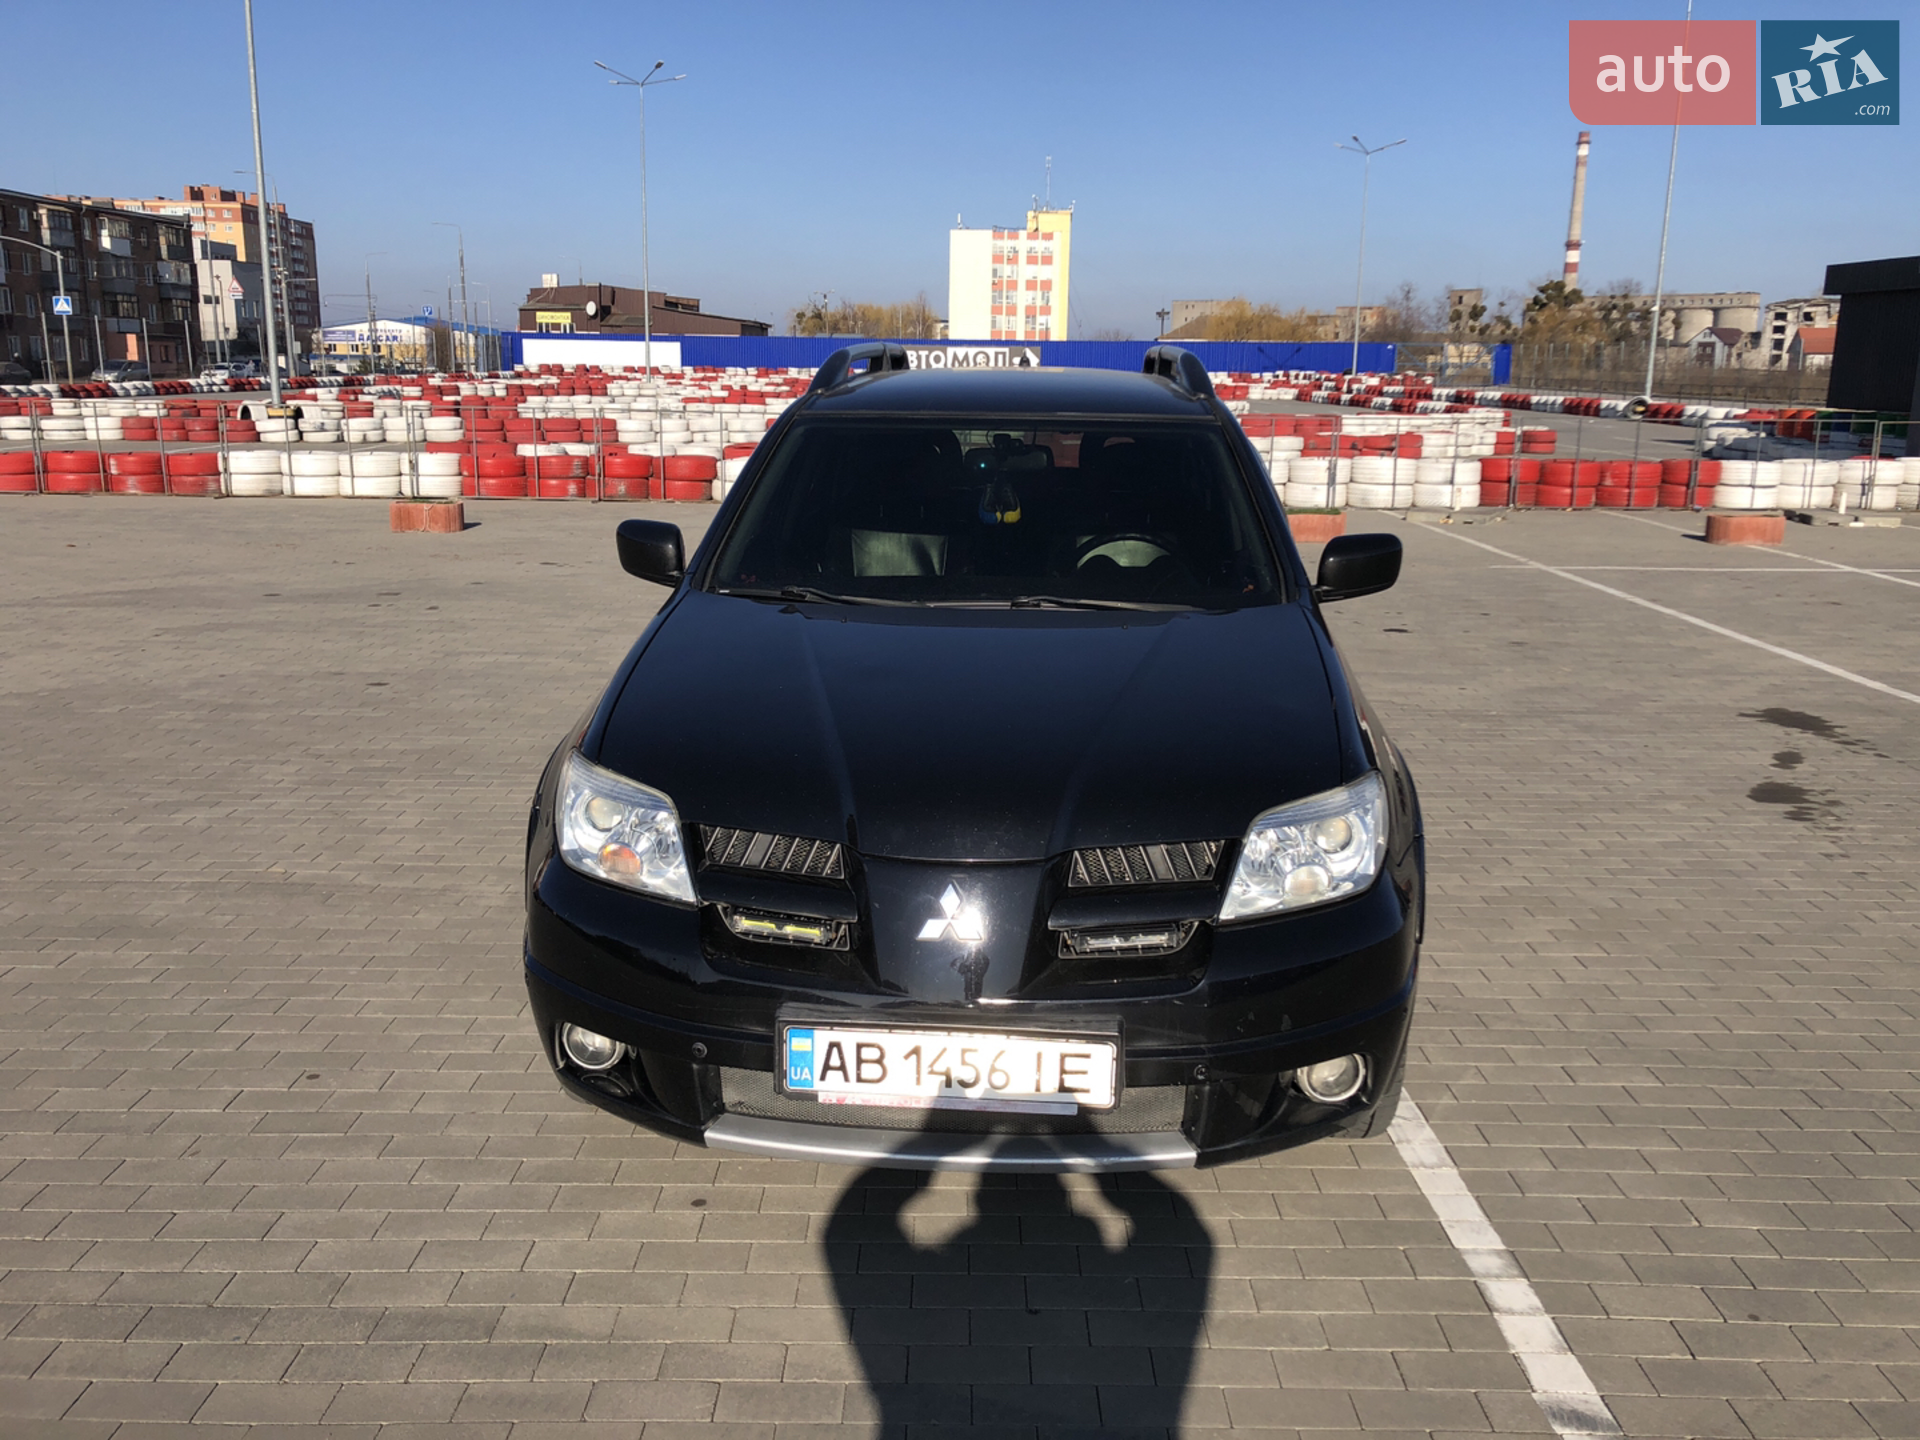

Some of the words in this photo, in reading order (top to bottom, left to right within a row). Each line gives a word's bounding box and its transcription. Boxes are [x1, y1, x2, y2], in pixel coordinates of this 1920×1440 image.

[791, 1066, 812, 1081] UA
[819, 1041, 888, 1084] AB
[903, 1045, 1010, 1090] 1456
[1035, 1051, 1091, 1093] IE
